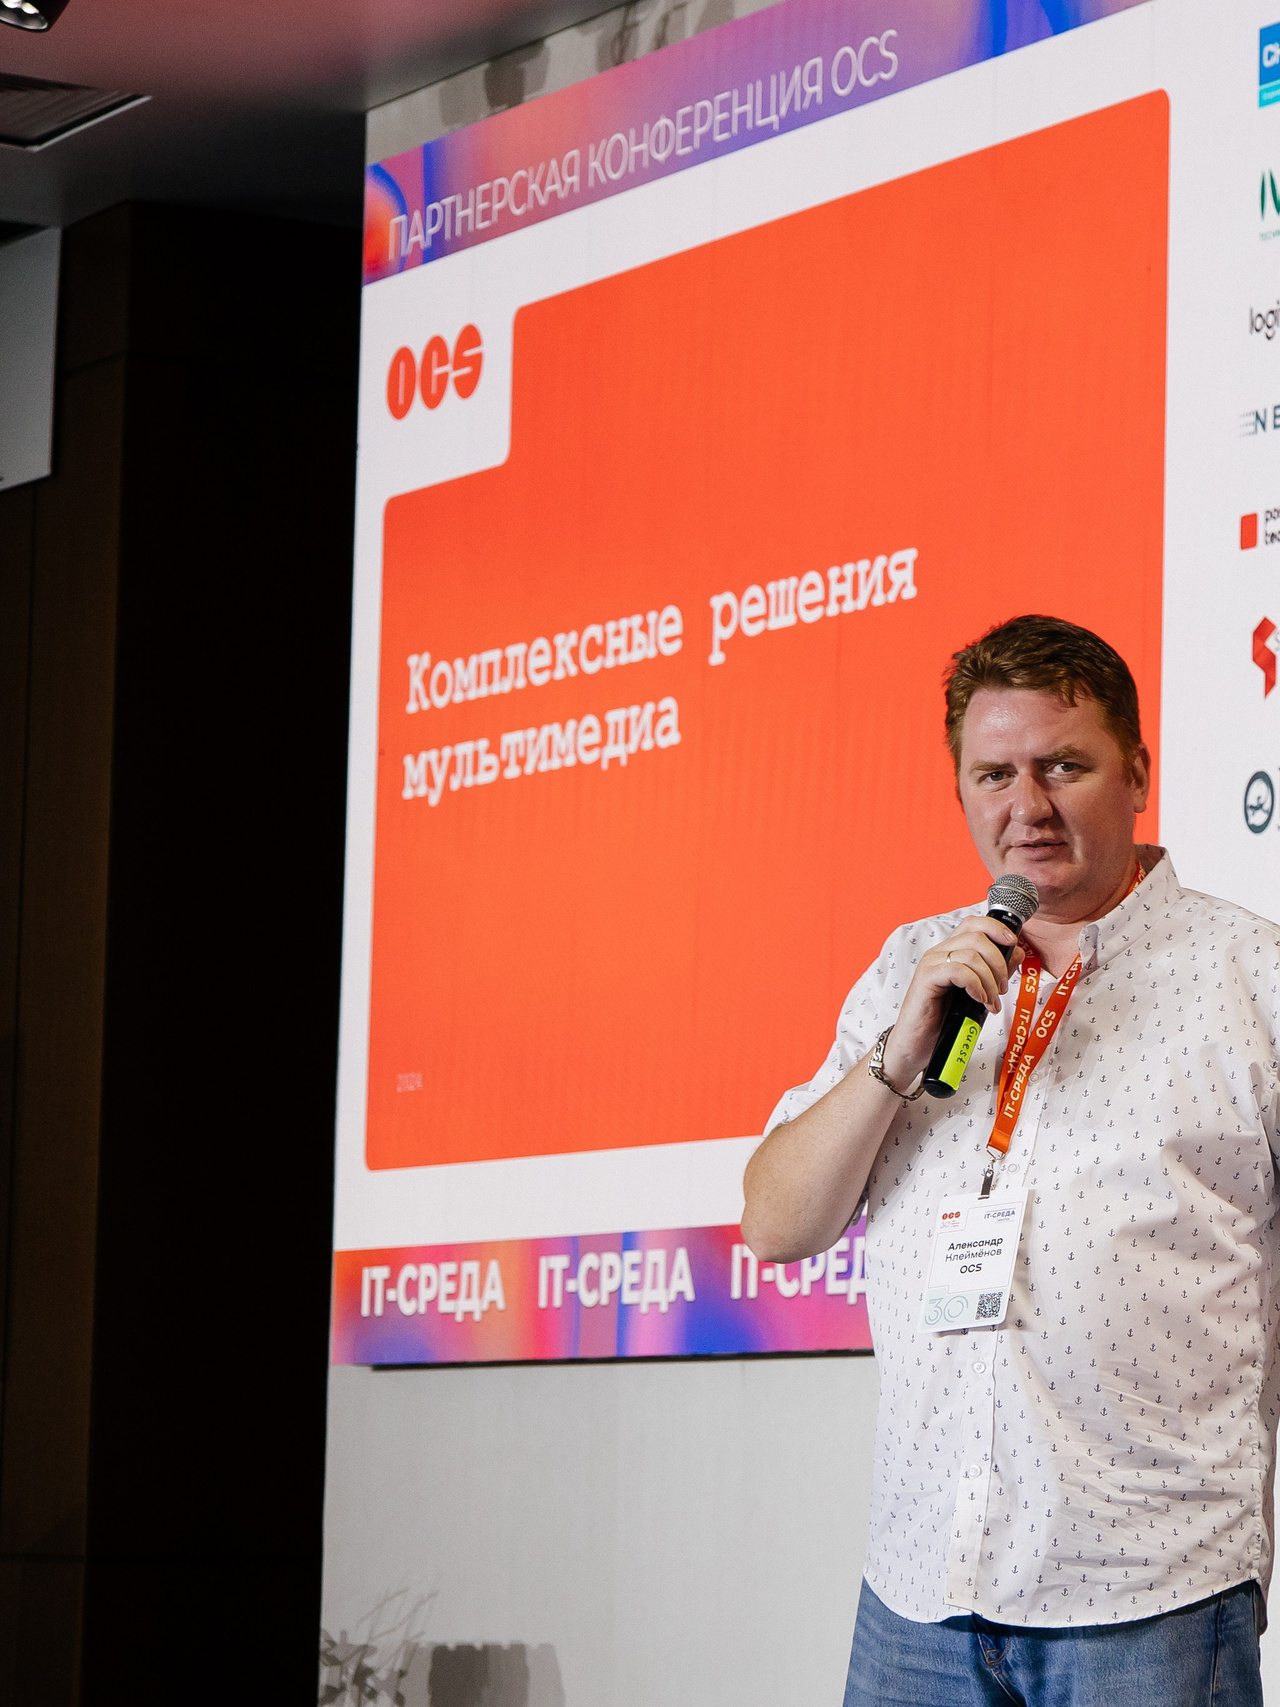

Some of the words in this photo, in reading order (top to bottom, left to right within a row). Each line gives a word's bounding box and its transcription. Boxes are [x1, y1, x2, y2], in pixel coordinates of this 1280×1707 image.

[388, 149, 581, 262] ПАРТНЕРСКАЯ
[587, 57, 823, 187] КОНФЕРЕНЦИЯ
[831, 29, 899, 97] OCS
[386, 323, 483, 420] OCS
[405, 605, 684, 714] Комплексные
[708, 547, 918, 666] решения
[402, 696, 682, 807] мультимедиа
[1036, 1009, 1056, 1038] OCS
[956, 1026, 979, 1065] Guest
[1003, 1054, 1035, 1118] IT-СРЕДА
[941, 1211, 961, 1220] OCS
[945, 1248, 1002, 1262] Клеймёнов
[948, 1237, 1004, 1251] Александр
[360, 1258, 506, 1322] IT-СРЕДА
[538, 1246, 695, 1313] IT-СРЕДА
[731, 1235, 866, 1305] IT-СРЕД
[960, 1263, 982, 1274] OCS
[924, 1295, 969, 1326] 30
